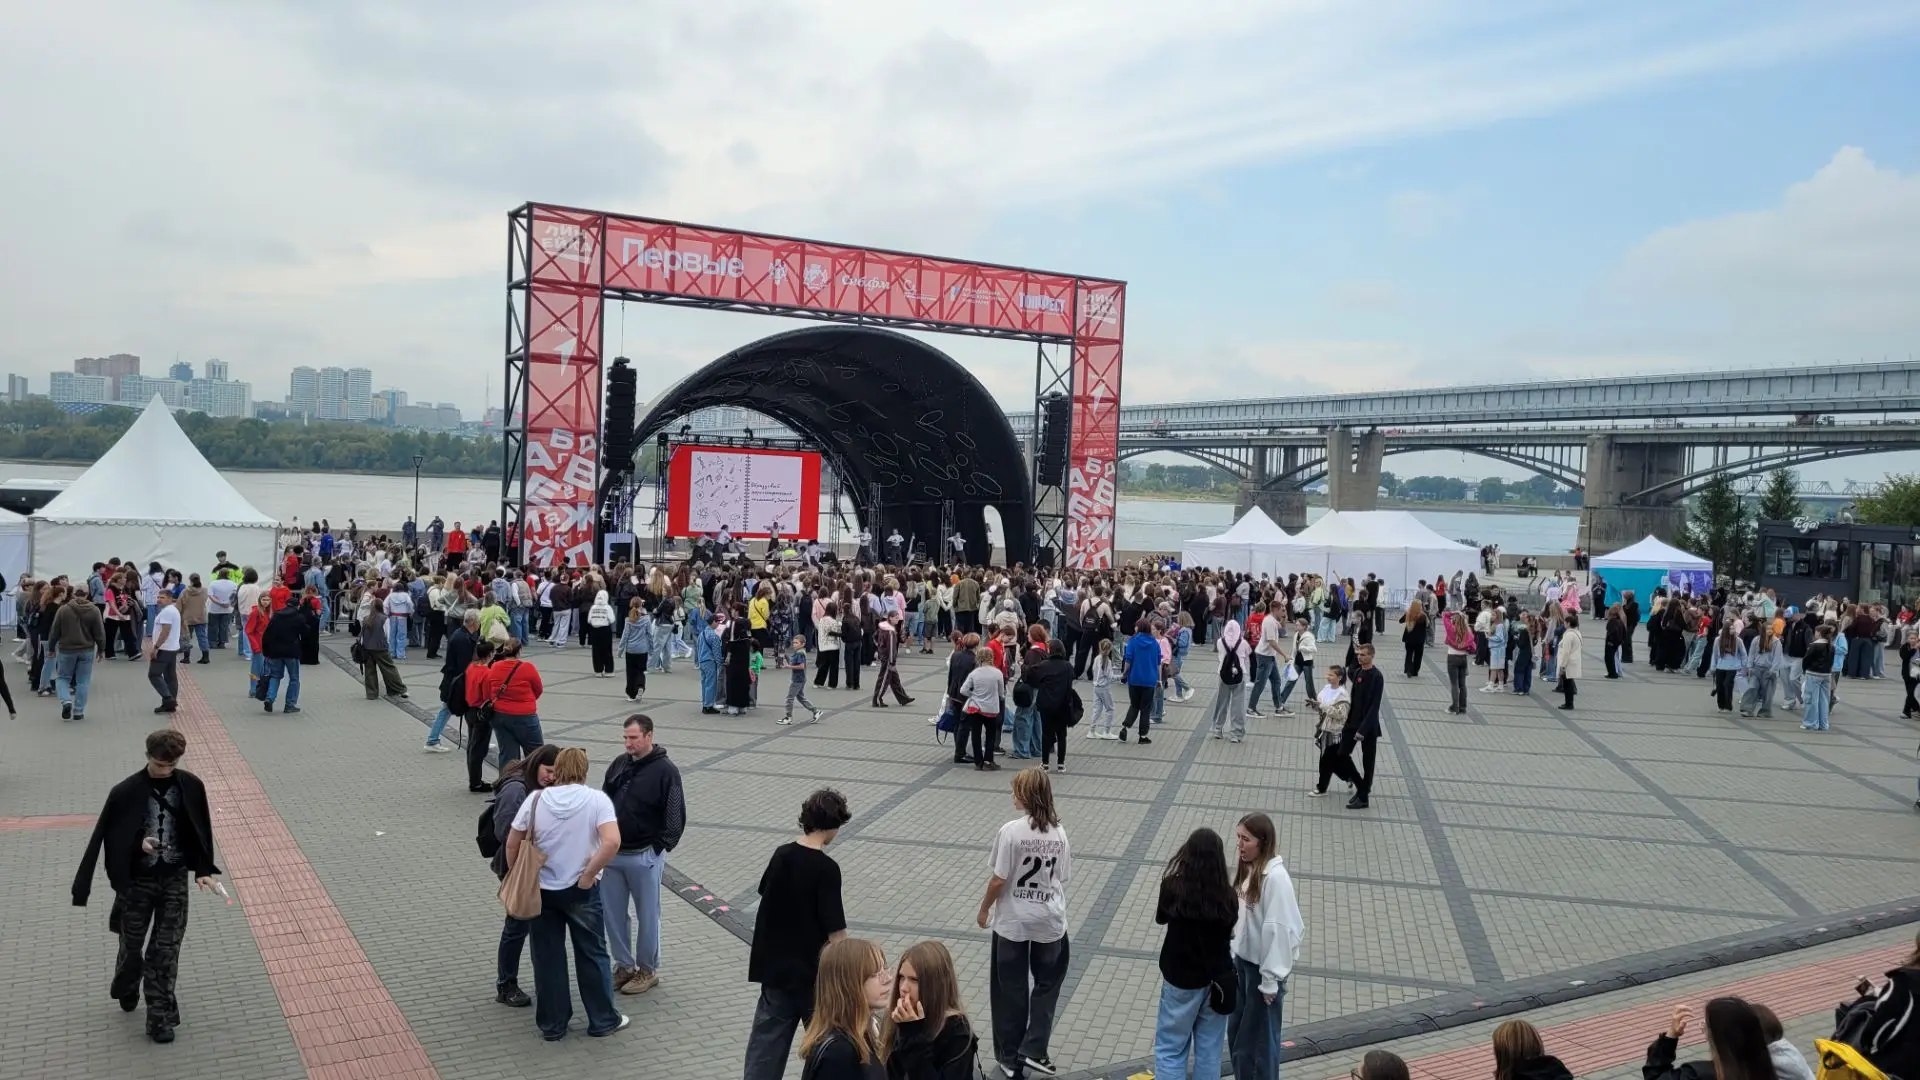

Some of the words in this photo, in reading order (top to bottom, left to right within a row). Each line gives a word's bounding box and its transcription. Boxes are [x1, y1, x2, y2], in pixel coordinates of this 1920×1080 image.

[622, 237, 744, 278] Первые
[527, 441, 557, 471] А
[1069, 467, 1090, 491] А
[1017, 856, 1057, 888] 21
